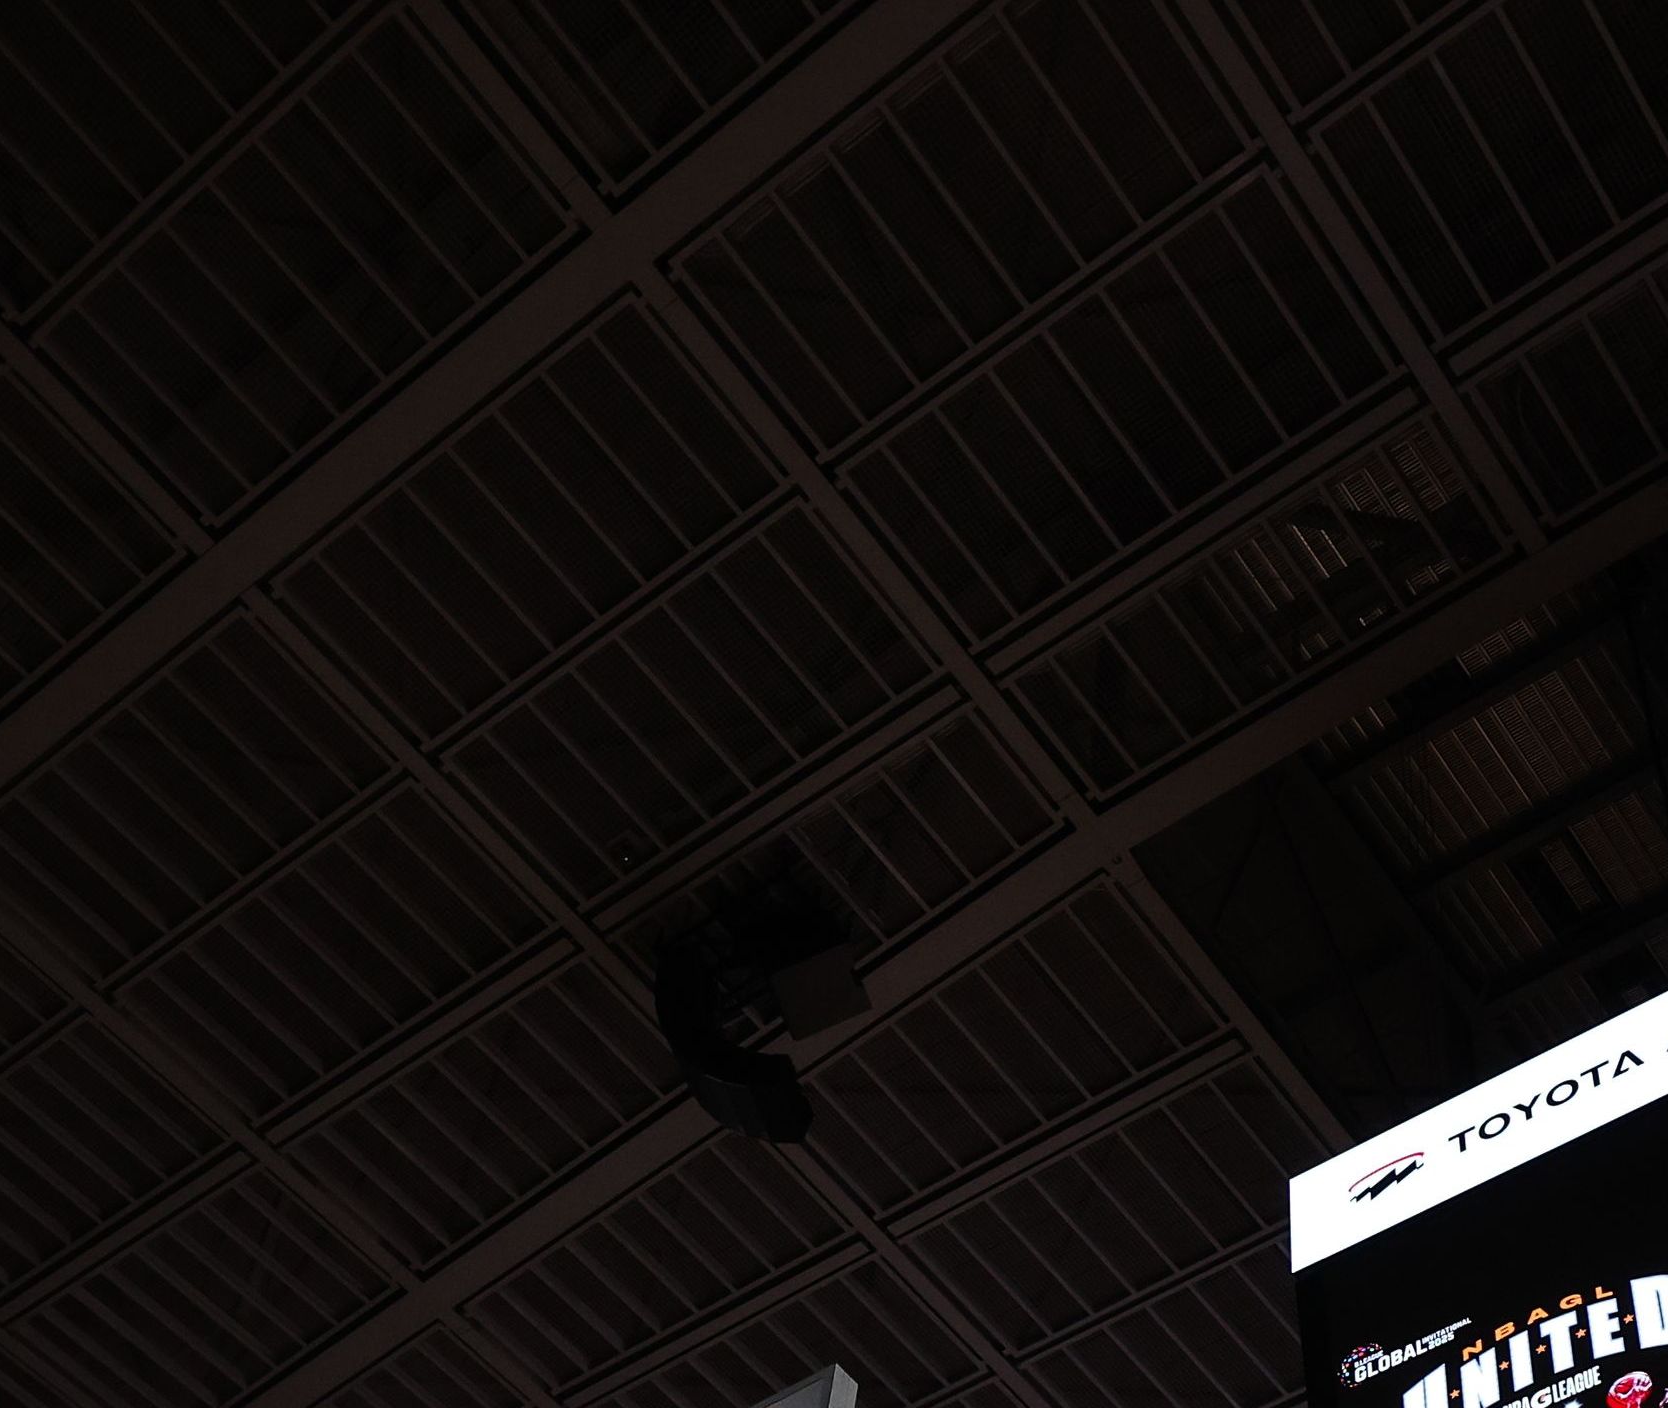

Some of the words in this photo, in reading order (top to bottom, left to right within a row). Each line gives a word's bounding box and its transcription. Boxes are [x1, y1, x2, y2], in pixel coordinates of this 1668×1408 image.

[1447, 1049, 1644, 1153] TOYOTA
[1422, 1317, 1472, 1345] INVITATIONAL
[1428, 1331, 1455, 1350] 2025
[1354, 1340, 1428, 1383] GLOBAL
